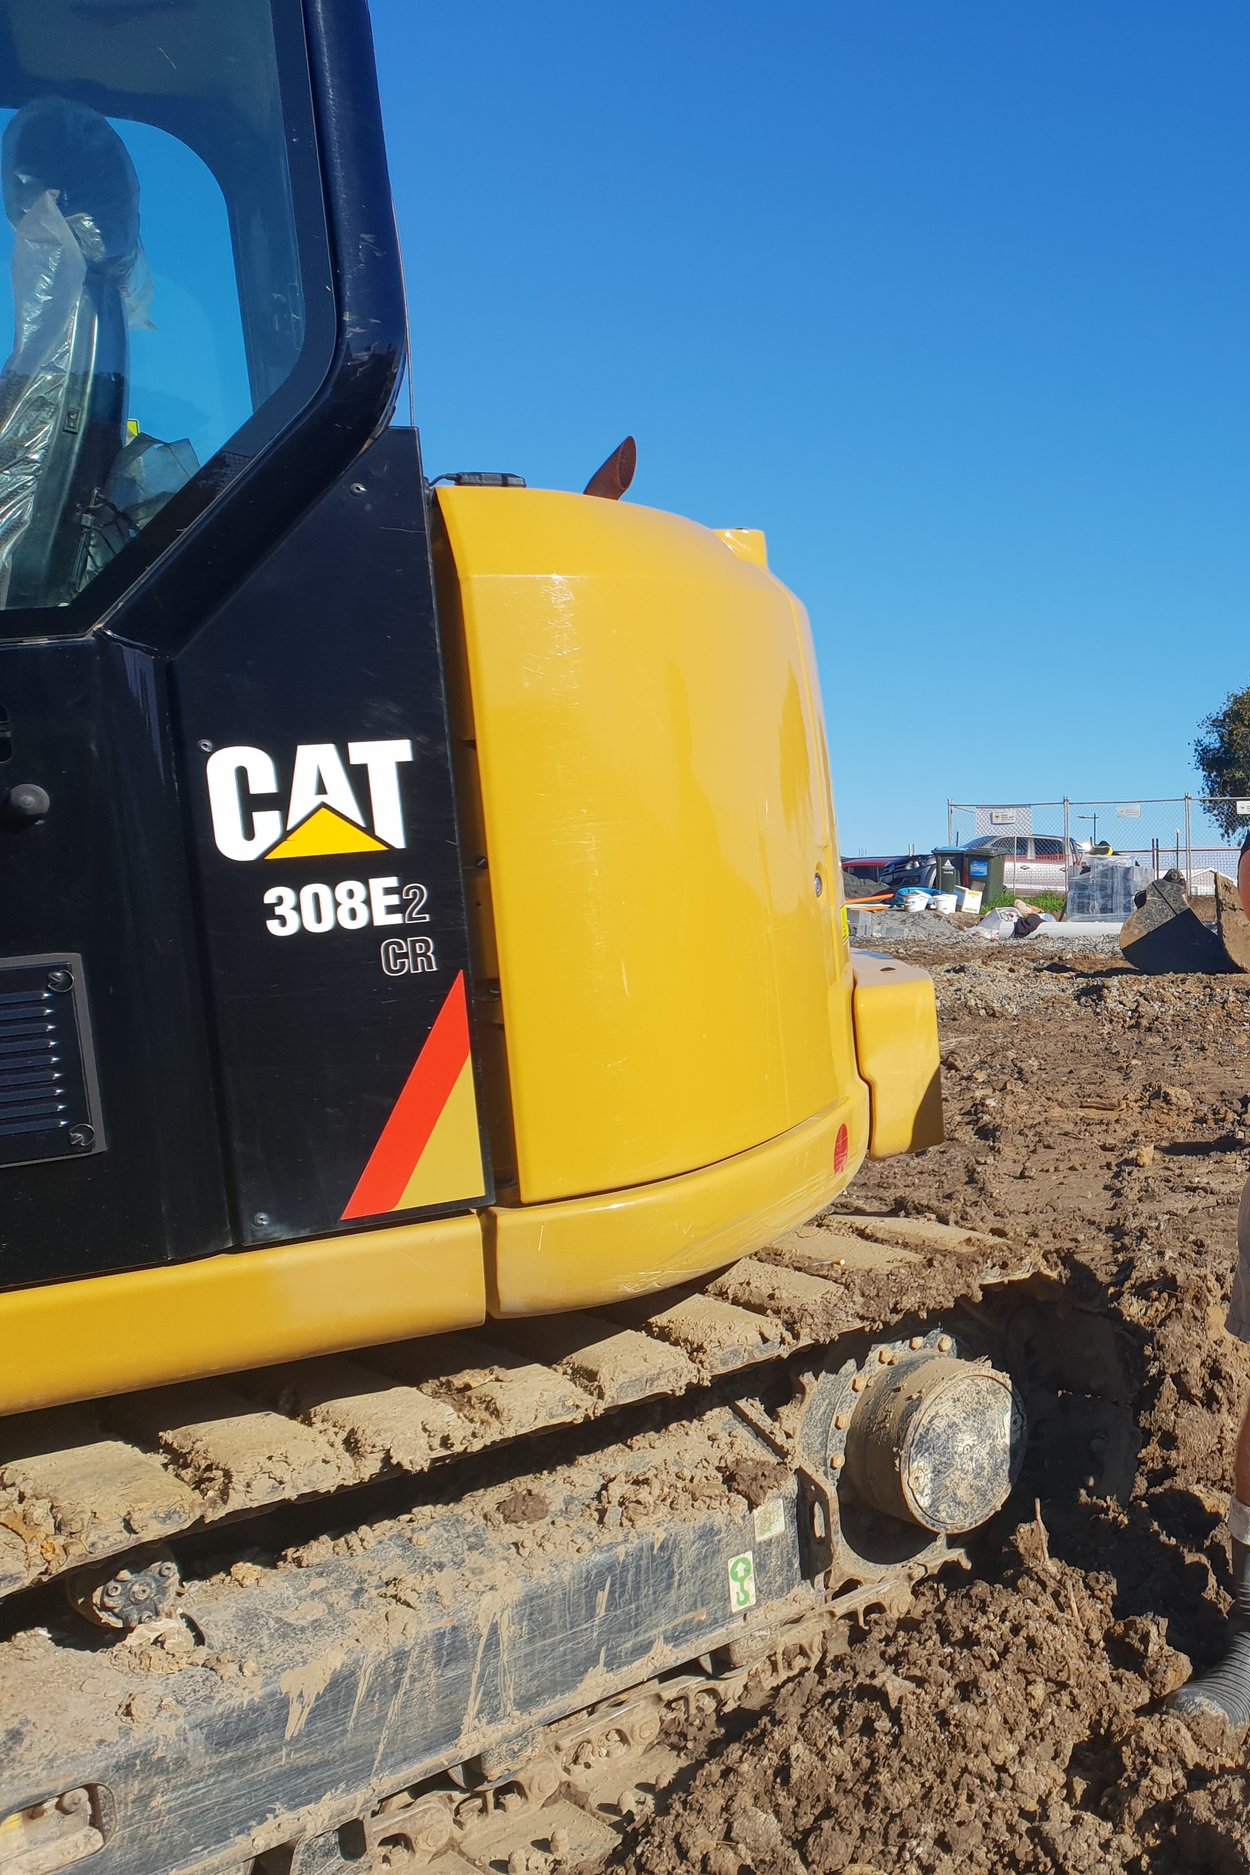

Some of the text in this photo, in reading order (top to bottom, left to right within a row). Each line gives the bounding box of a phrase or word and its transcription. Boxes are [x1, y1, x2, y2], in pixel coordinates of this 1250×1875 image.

[206, 739, 414, 862] CAT
[263, 877, 430, 937] 308E2
[380, 937, 438, 977] CR
